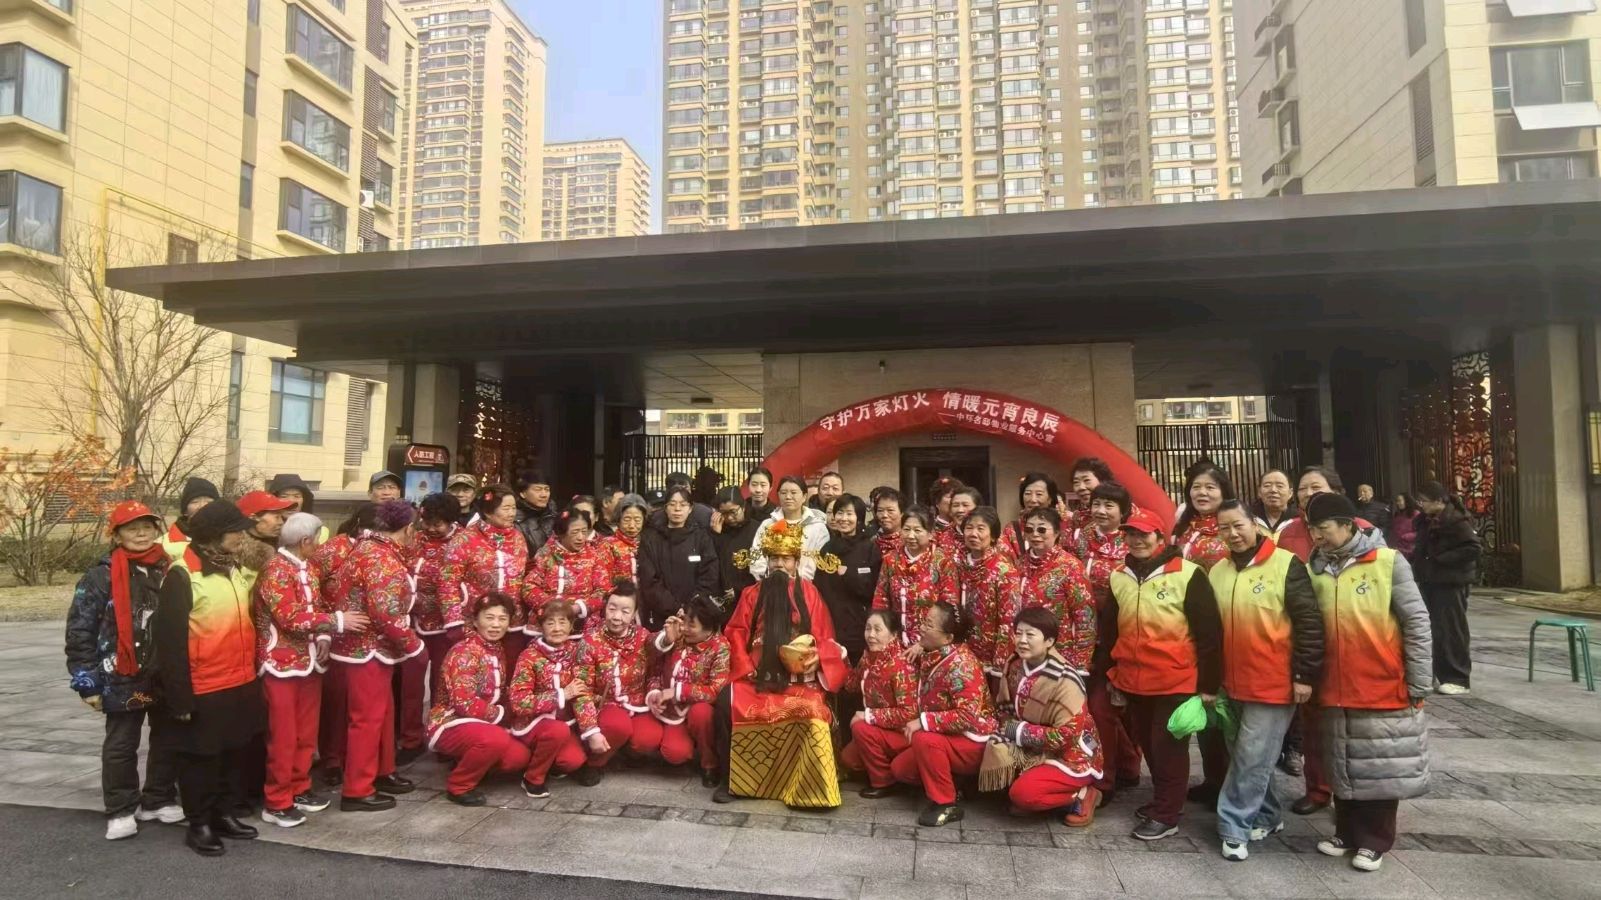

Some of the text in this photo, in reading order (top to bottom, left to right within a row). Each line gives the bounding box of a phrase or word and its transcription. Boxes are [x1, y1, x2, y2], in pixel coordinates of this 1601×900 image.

[819, 391, 1060, 433] 守护万家灯火 情暖元宵良辰
